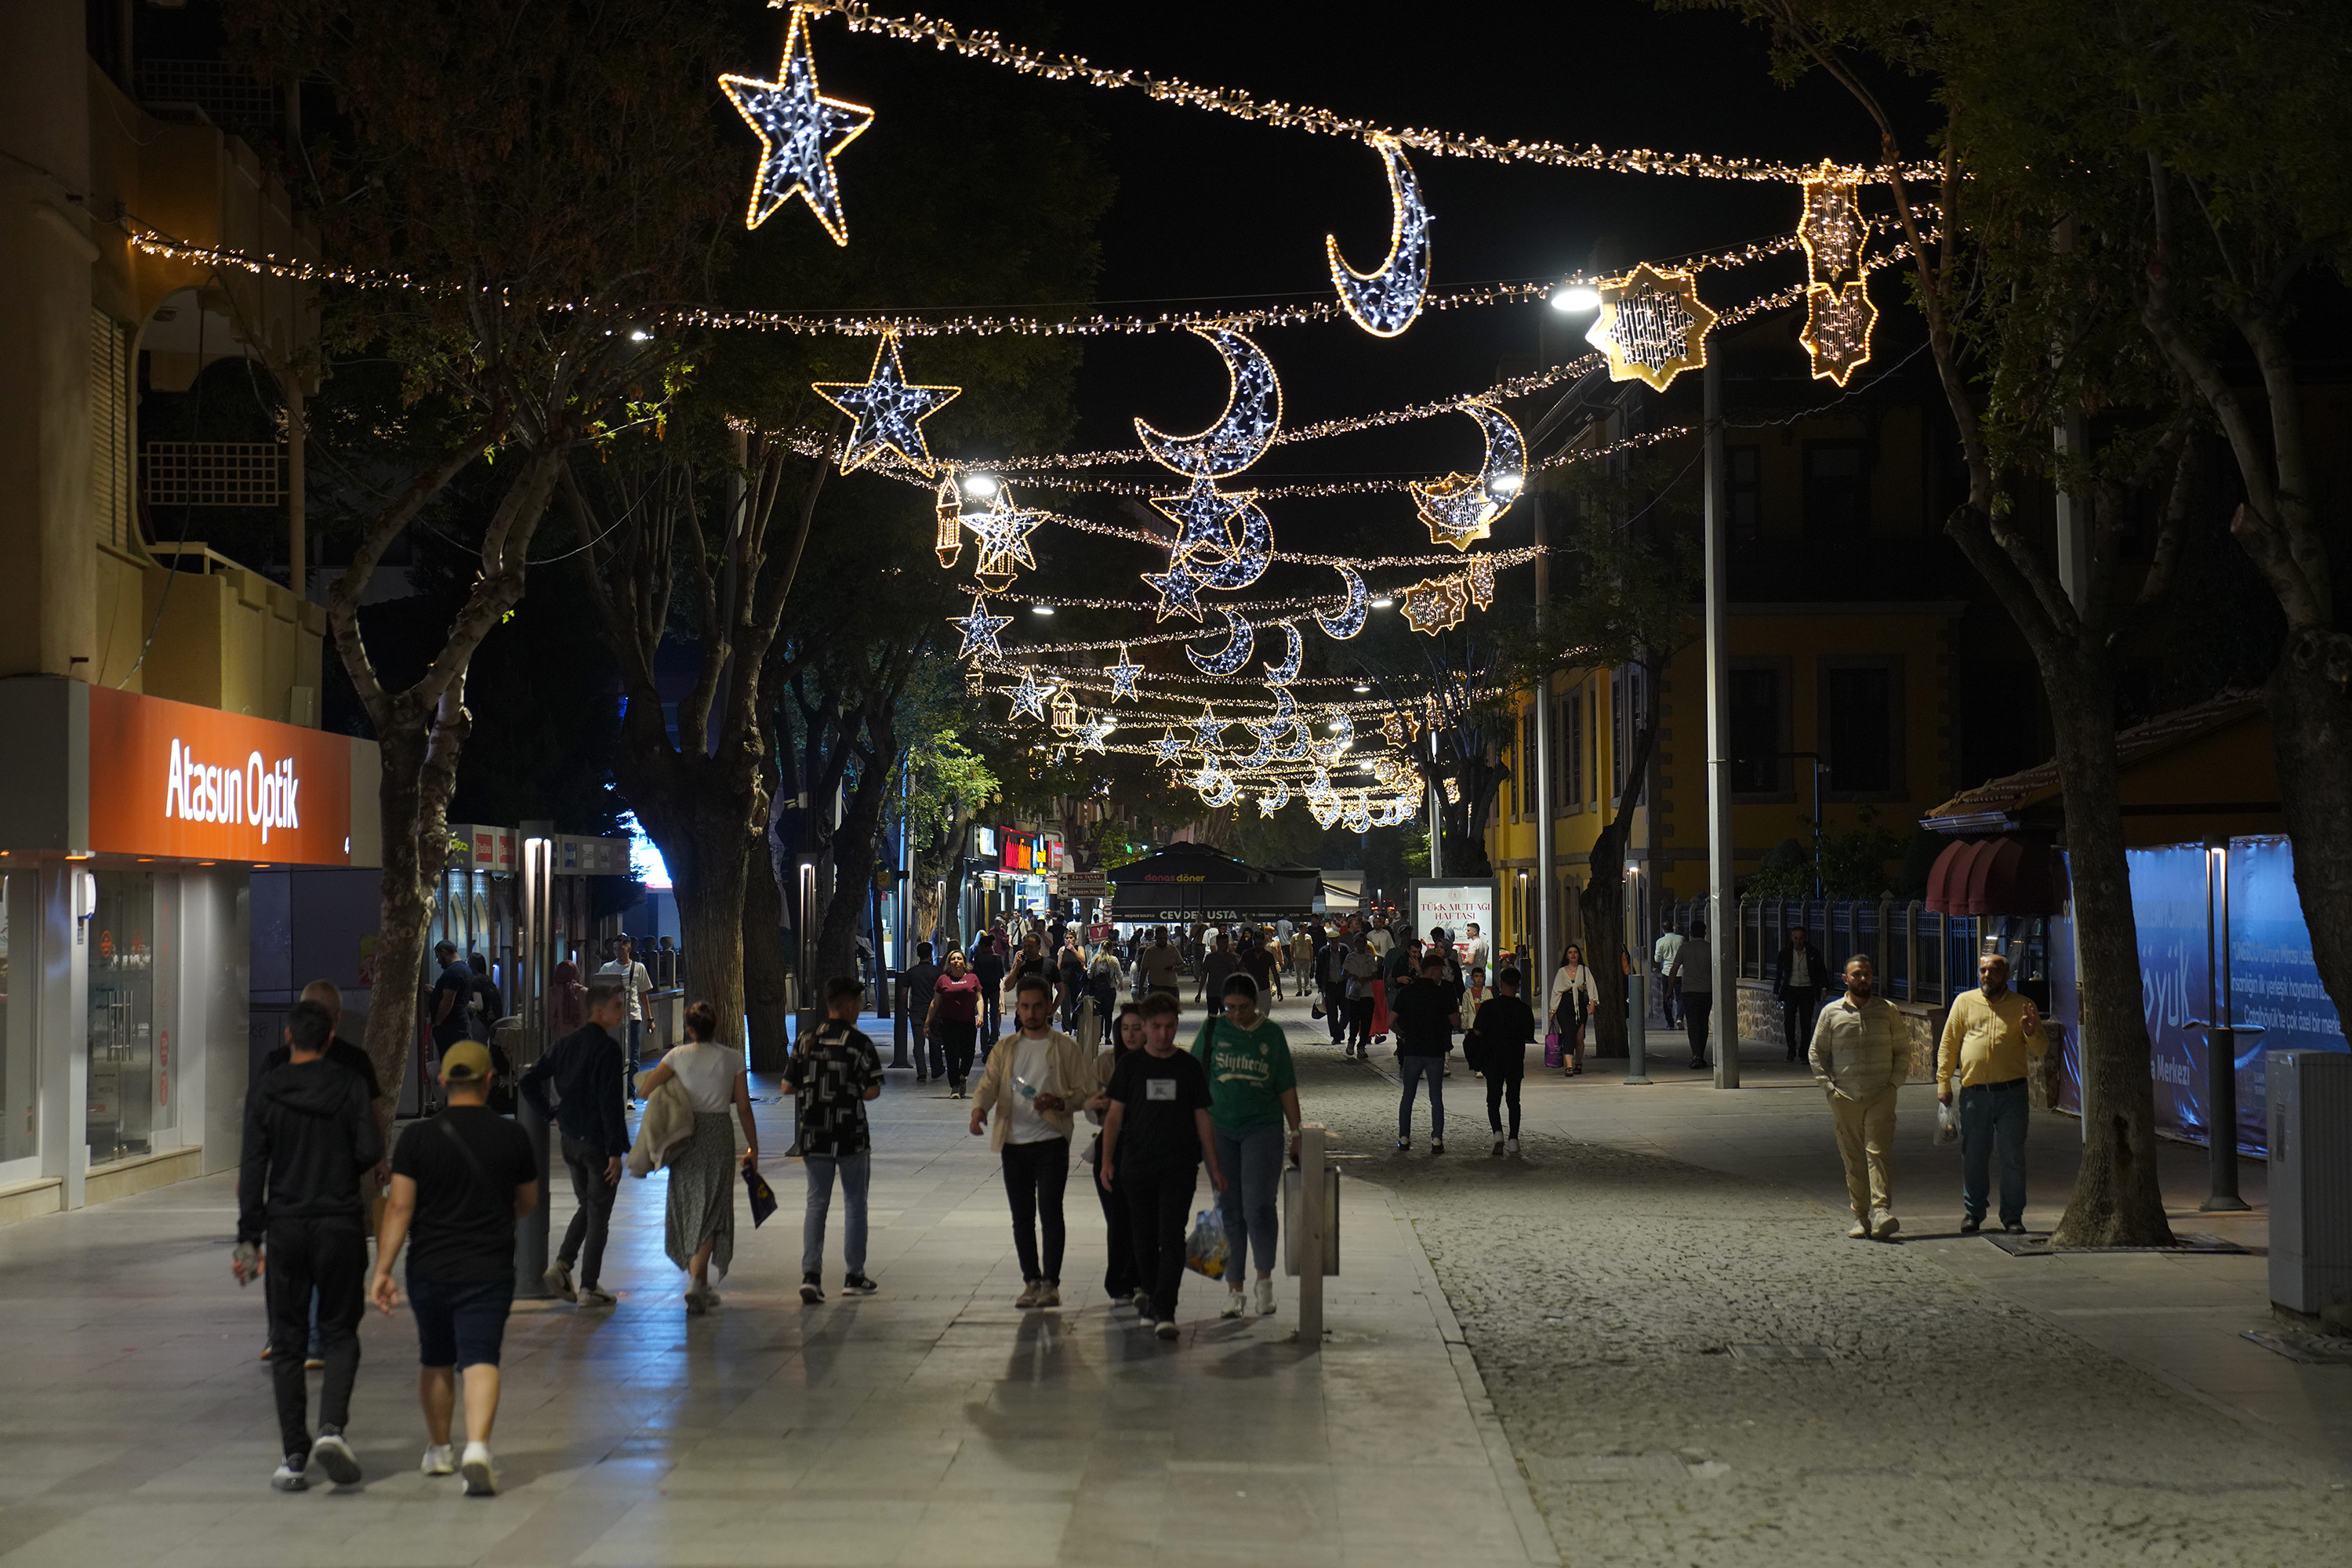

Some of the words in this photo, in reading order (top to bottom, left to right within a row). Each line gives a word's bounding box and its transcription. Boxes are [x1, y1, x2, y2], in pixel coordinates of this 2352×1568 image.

[165, 737, 242, 825] Atasun
[246, 750, 300, 845] Optik
[1176, 873, 1206, 882] döner
[1421, 902, 1446, 911] TÜRK
[1207, 910, 1238, 920] USTA
[1436, 912, 1475, 920] HAFTASI
[2311, 1011, 2321, 1033] bir
[2157, 1054, 2190, 1087] Merkezi
